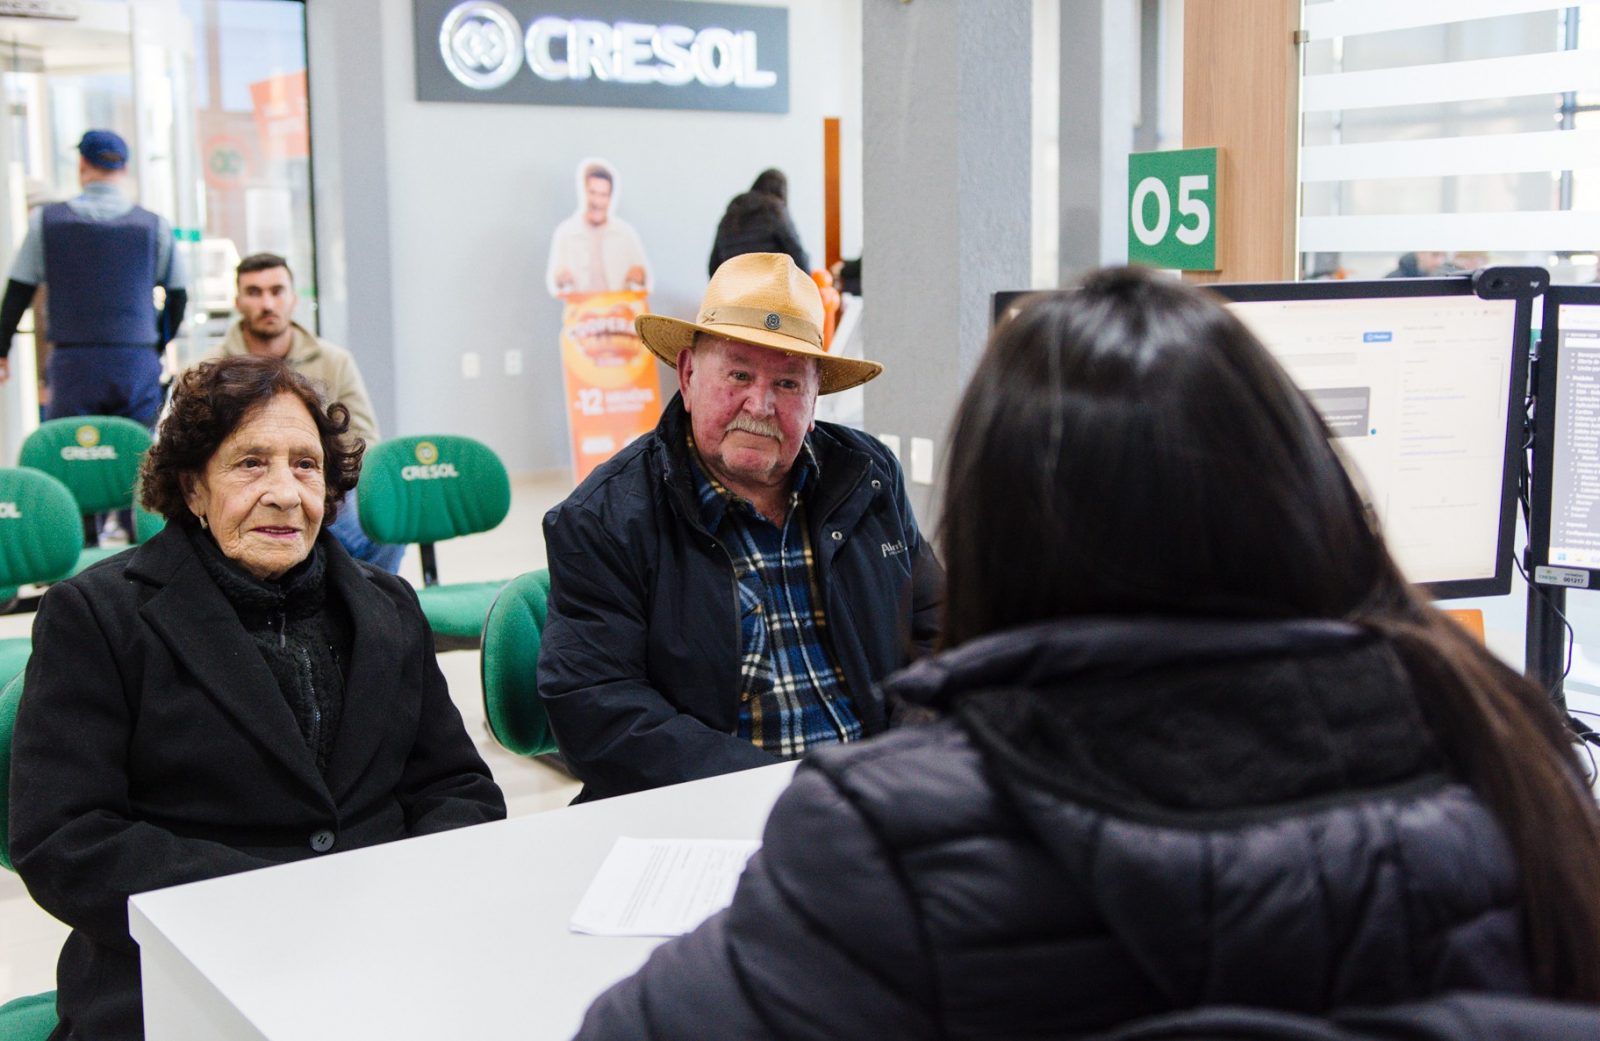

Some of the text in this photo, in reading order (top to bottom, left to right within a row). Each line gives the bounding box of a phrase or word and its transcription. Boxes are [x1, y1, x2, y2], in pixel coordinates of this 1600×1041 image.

[525, 16, 777, 88] CRESOL
[1132, 175, 1210, 246] 05
[60, 445, 117, 460] CRESOL
[401, 463, 458, 480] CRESOL
